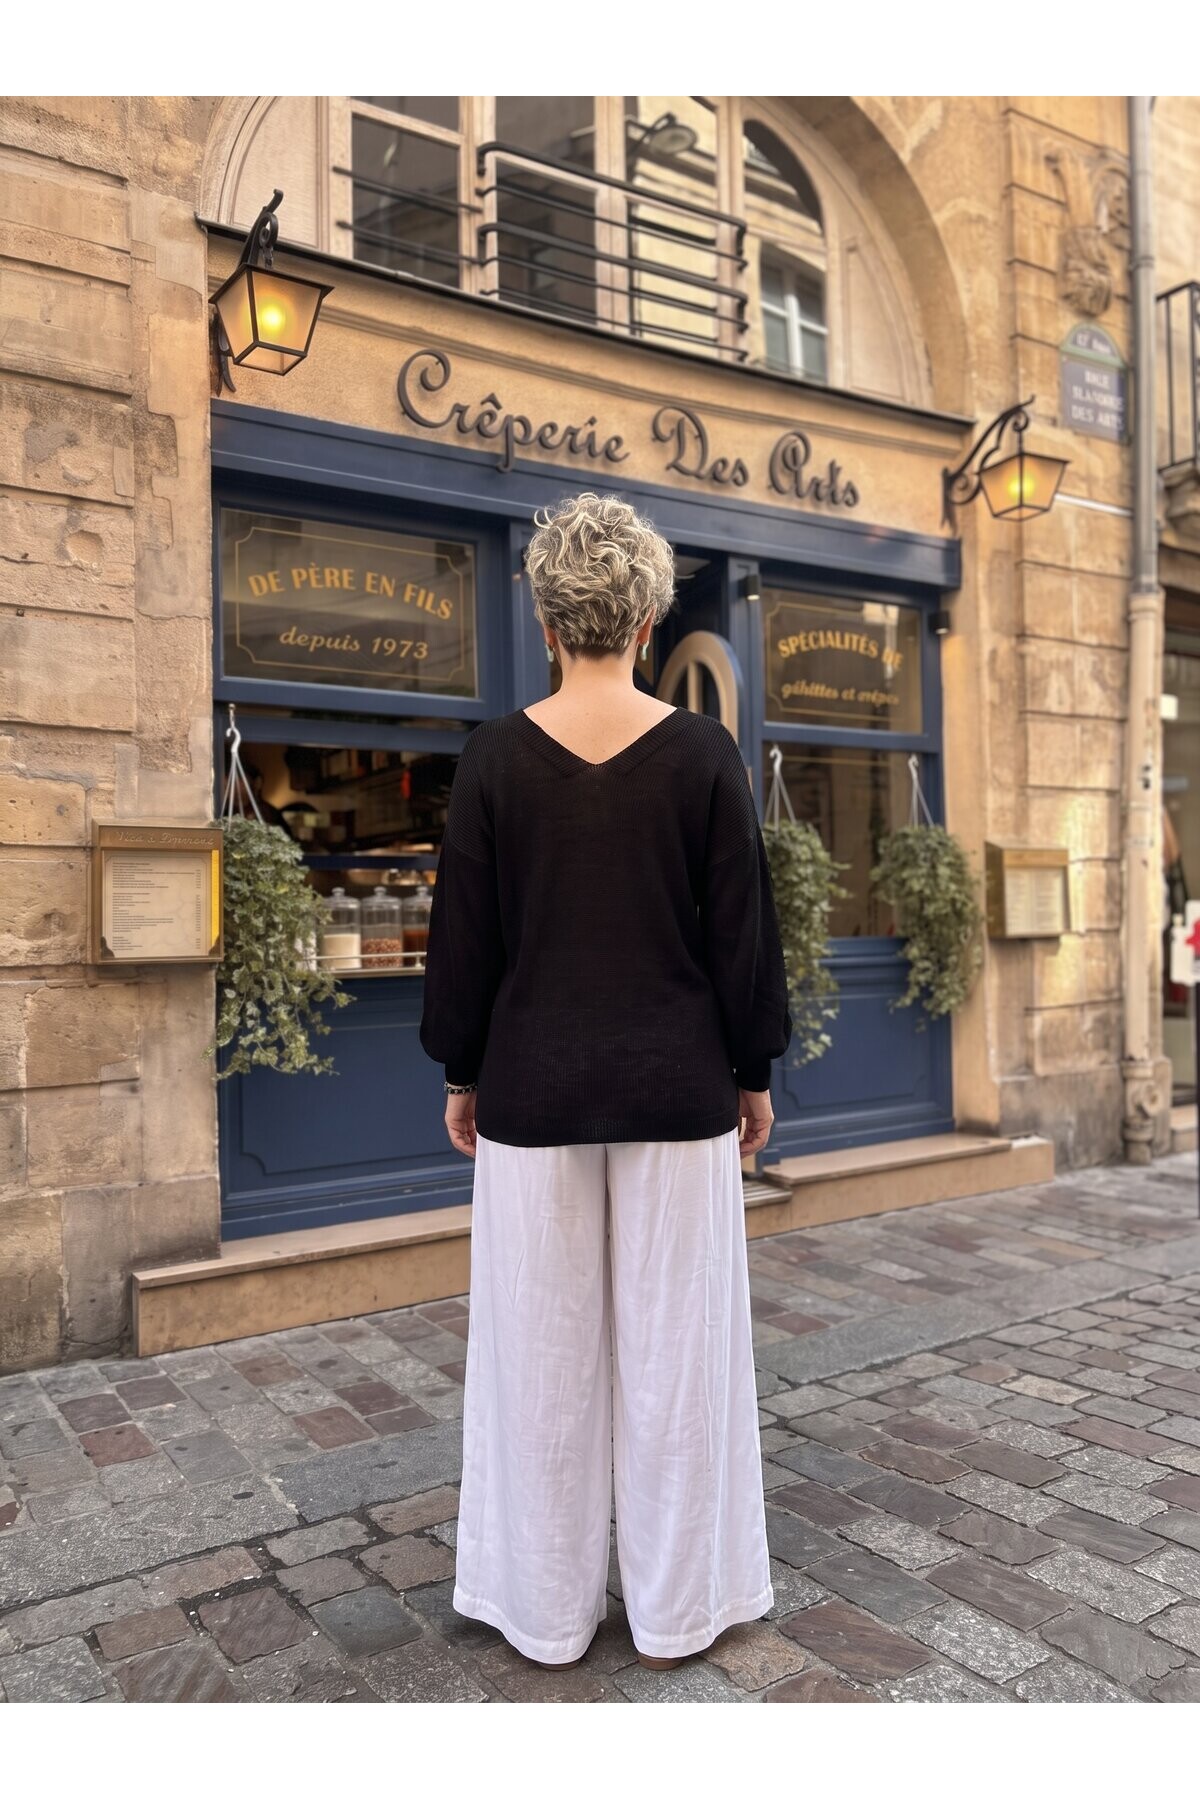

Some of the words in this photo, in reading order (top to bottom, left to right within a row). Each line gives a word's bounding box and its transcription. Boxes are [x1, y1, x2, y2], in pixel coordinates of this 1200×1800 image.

[397, 348, 630, 474] Crêperie
[652, 406, 750, 488] Des
[768, 430, 860, 508] Arts
[248, 570, 286, 597] DE
[291, 562, 356, 590] PÈRE
[365, 571, 397, 598] EN
[403, 582, 454, 621] FILS
[279, 625, 361, 652] depuis
[371, 636, 430, 660] 1973
[777, 628, 880, 659] SPÉCIALITÉS
